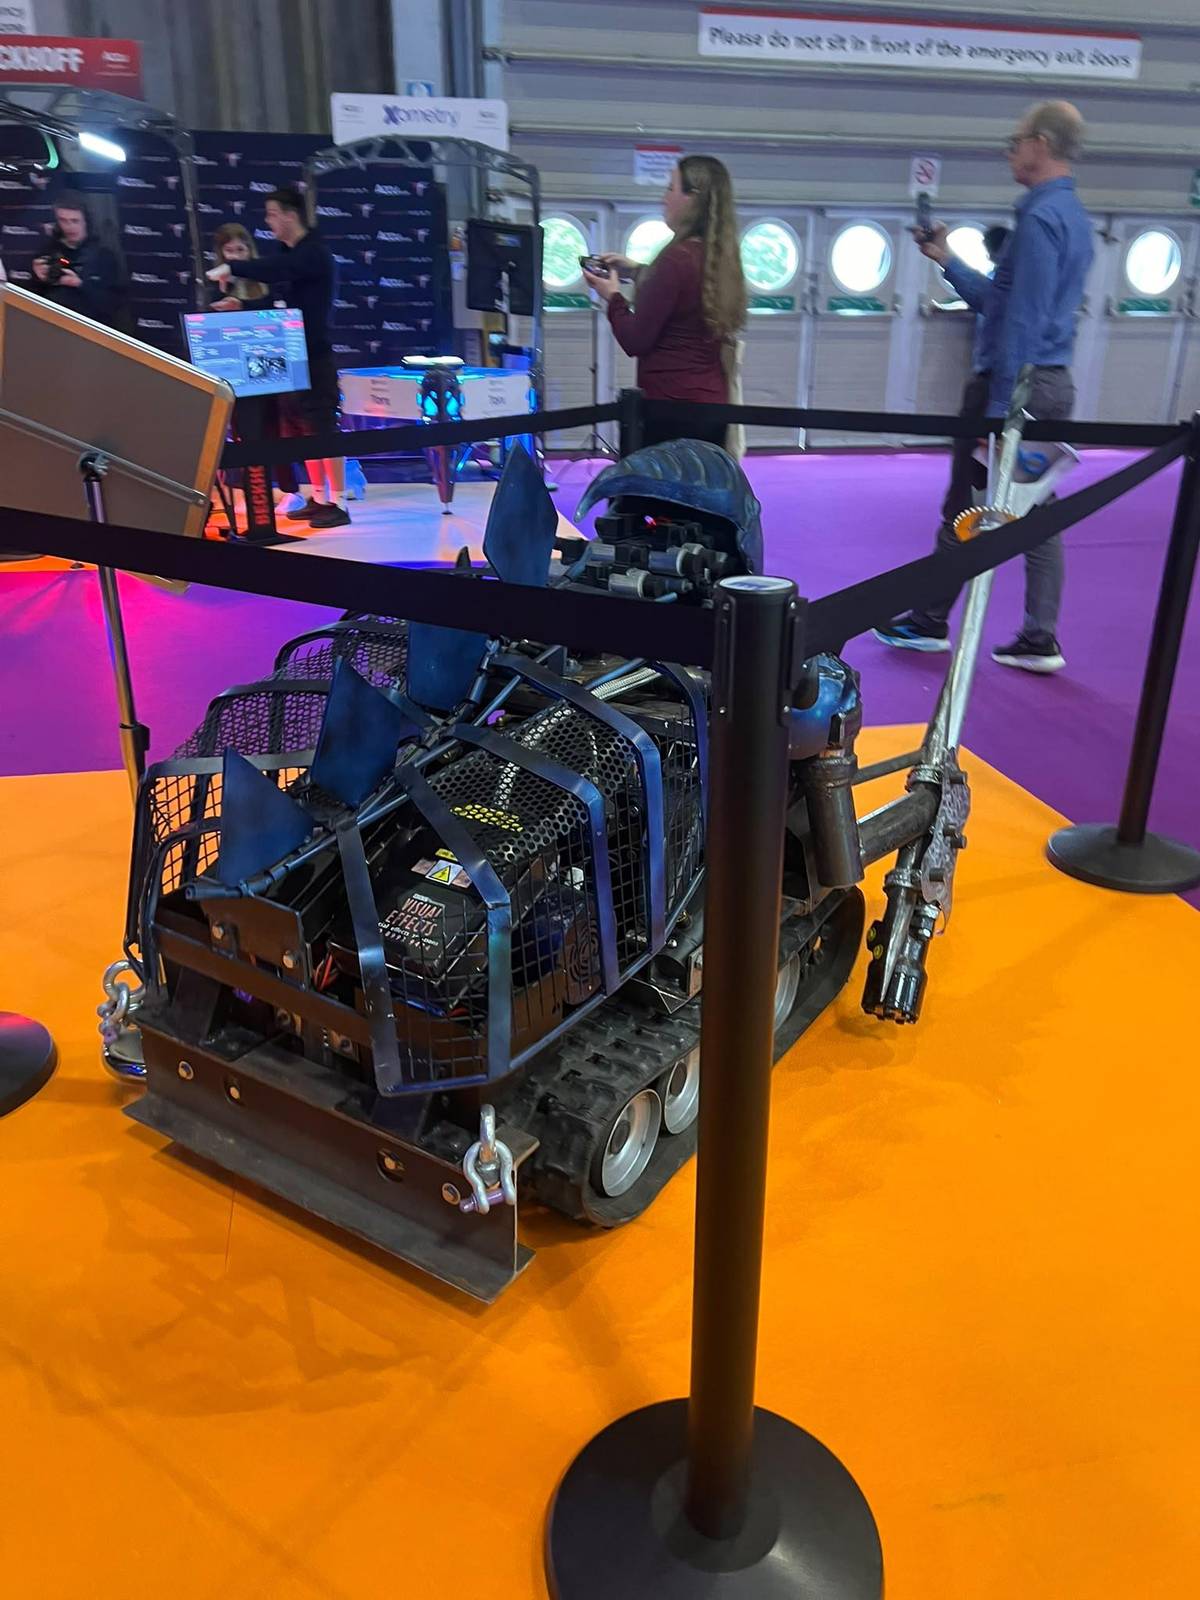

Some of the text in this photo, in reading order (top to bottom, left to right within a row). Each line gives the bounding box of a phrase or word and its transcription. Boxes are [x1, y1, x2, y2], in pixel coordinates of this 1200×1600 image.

[709, 26, 1132, 68] Please do not sit in front of the emergency exit doors
[385, 909, 438, 937] EFFECTS
